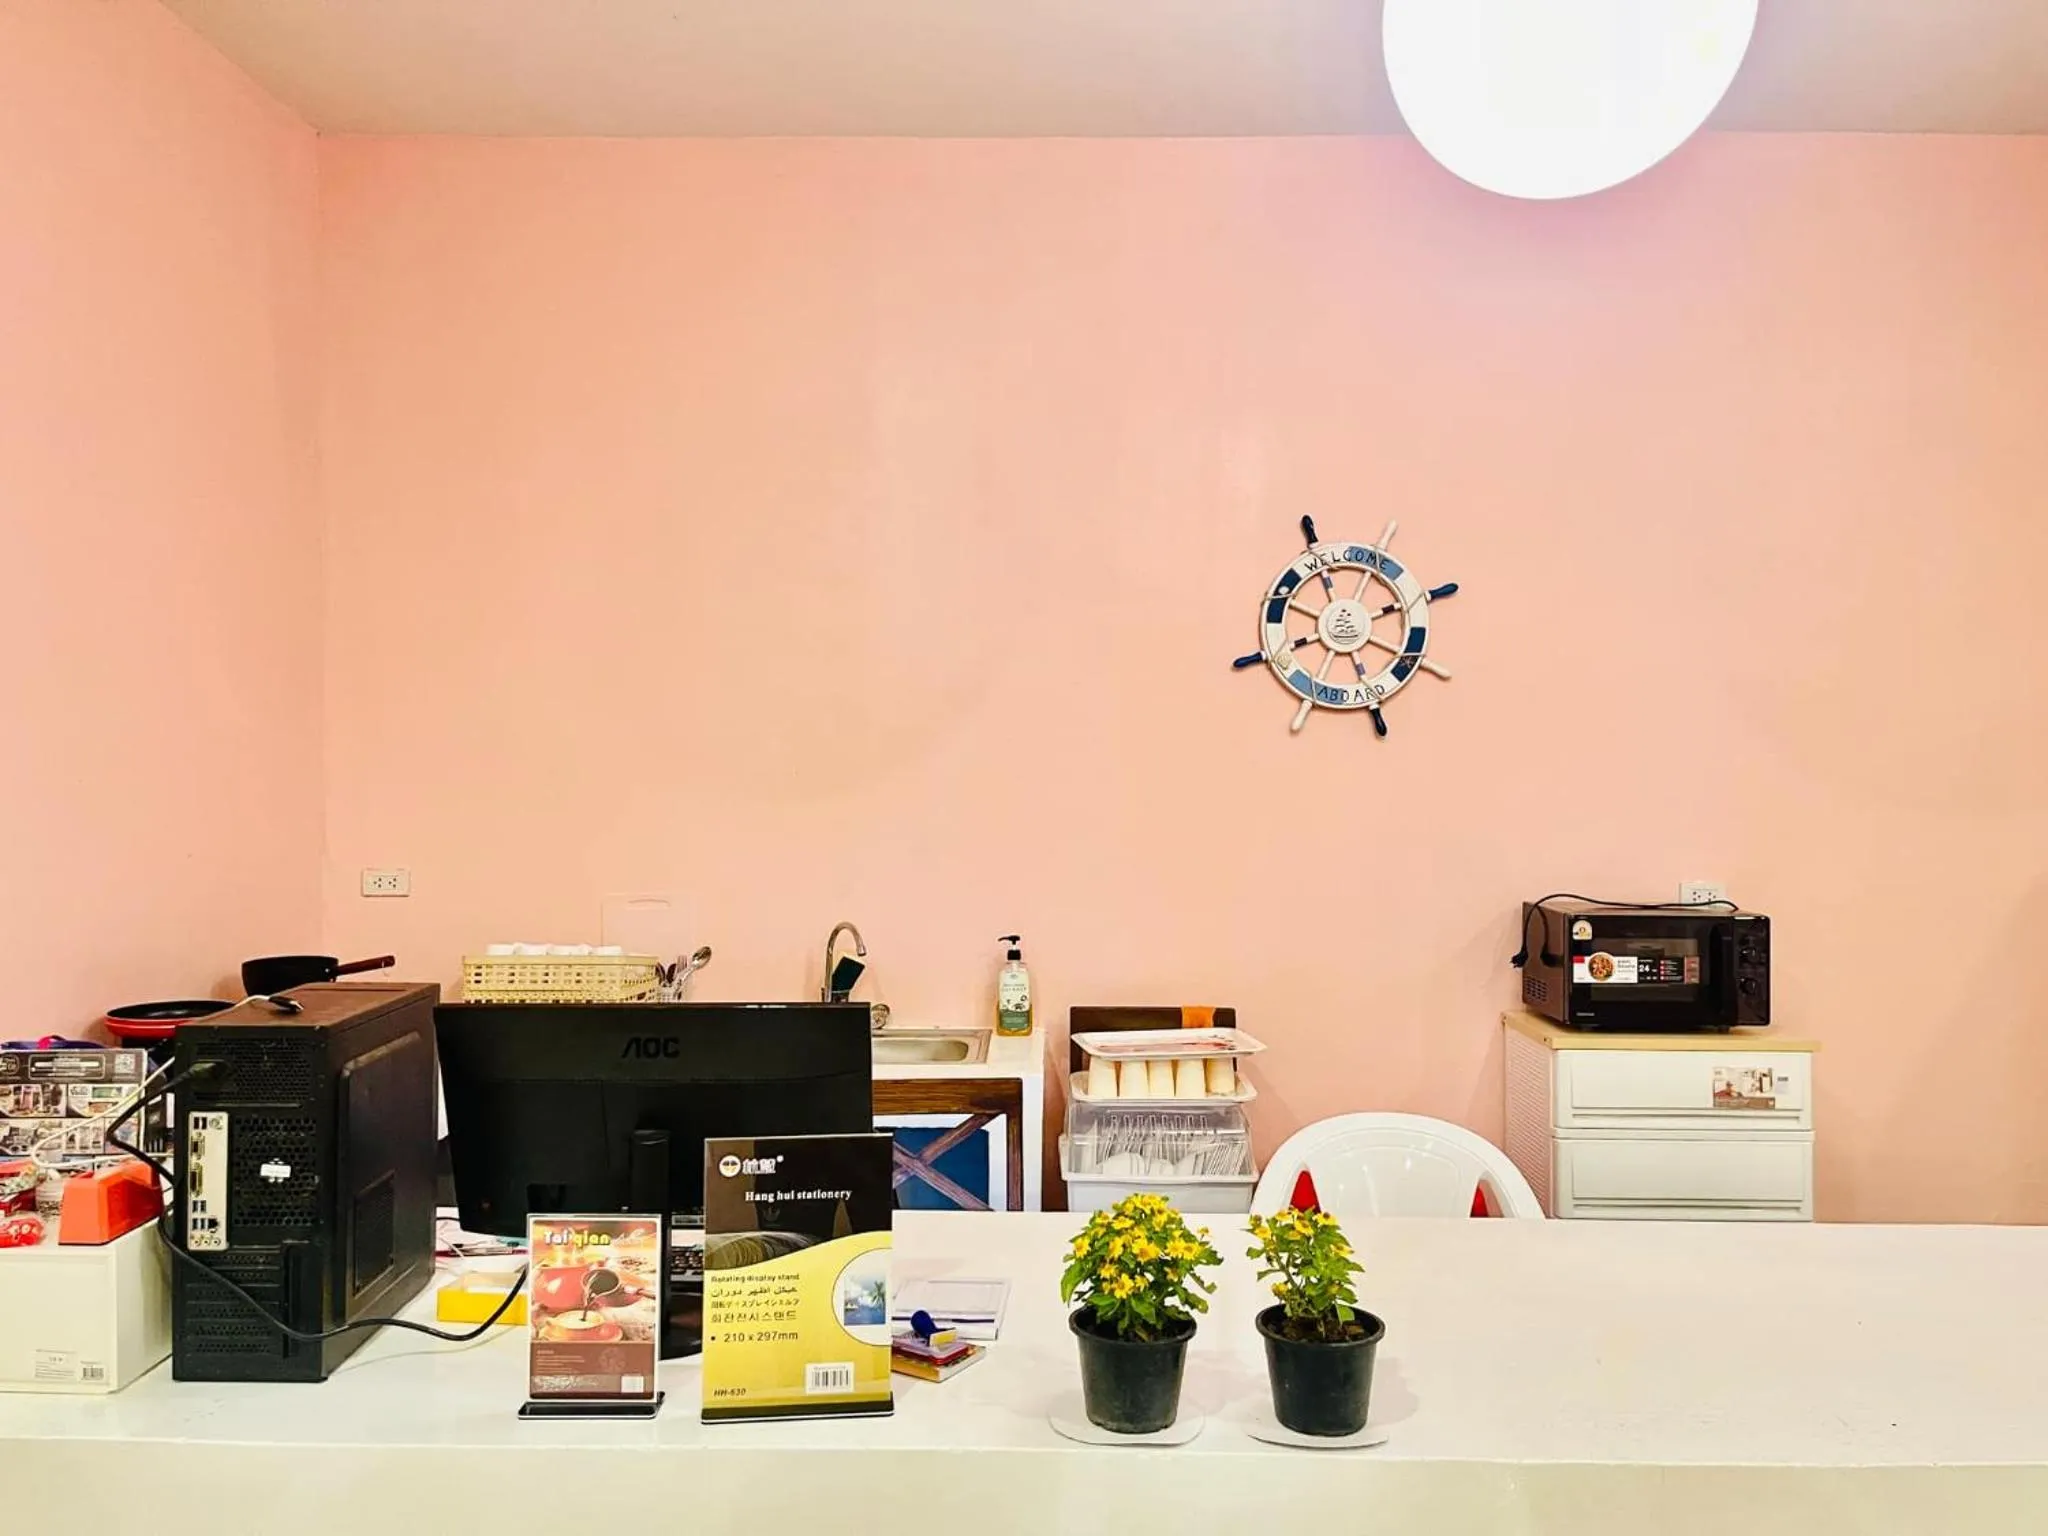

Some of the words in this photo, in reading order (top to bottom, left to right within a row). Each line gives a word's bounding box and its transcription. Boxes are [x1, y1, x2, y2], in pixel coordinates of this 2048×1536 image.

[1304, 549, 1389, 571] WELCOME
[1317, 684, 1386, 702] ABOARD
[621, 1037, 680, 1059] AOC
[745, 1191, 775, 1203] Hang
[797, 1188, 852, 1200] stationery
[724, 1332, 745, 1342] 210
[757, 1330, 798, 1342] 297mm
